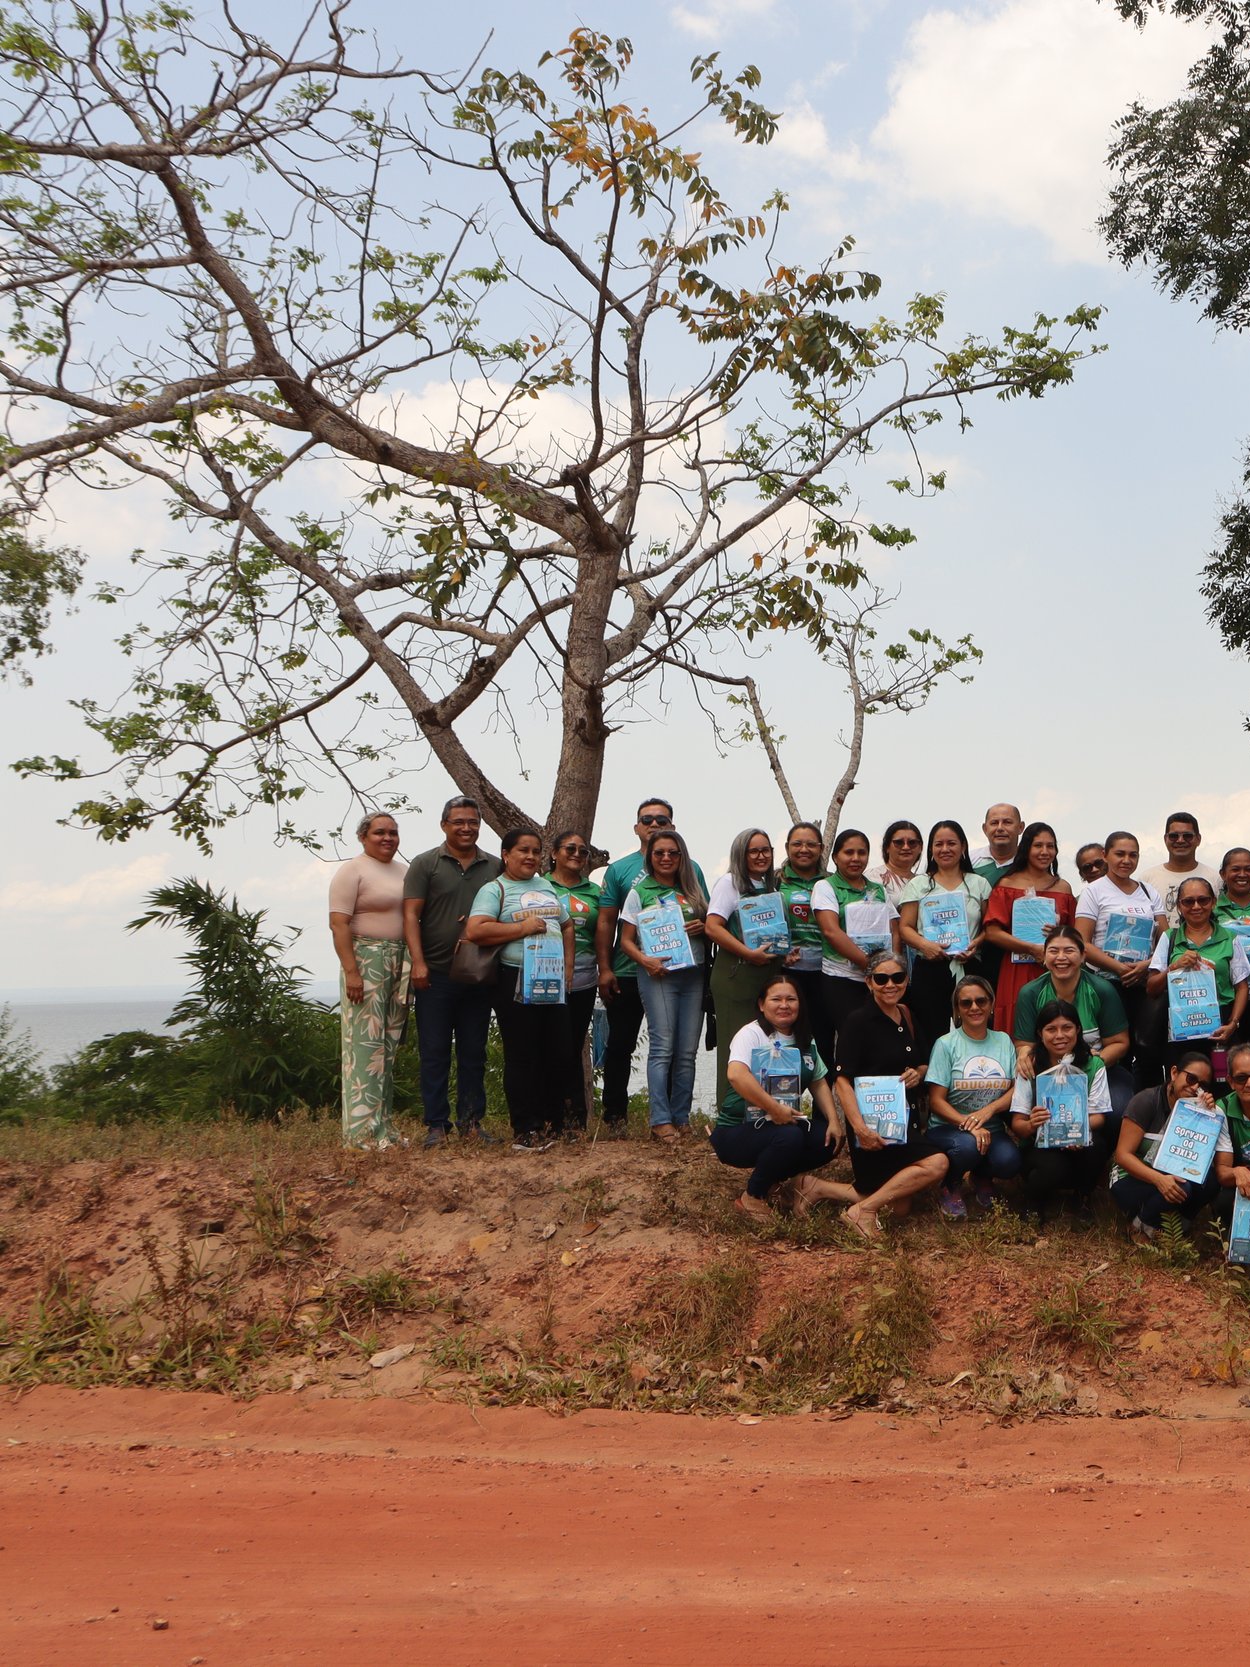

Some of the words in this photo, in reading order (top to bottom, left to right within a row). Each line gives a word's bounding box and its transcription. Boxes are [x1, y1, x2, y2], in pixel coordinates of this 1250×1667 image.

[751, 911, 775, 921] PEIXES
[651, 924, 676, 936] PEIXES
[651, 939, 682, 953] TAPAJÓS
[1180, 989, 1207, 998] PEIXES
[866, 1094, 894, 1103] PEIXES
[1175, 1126, 1208, 1144] TAPAJÓS
[1183, 1139, 1194, 1149] DO
[1170, 1145, 1199, 1161] PEIXES
